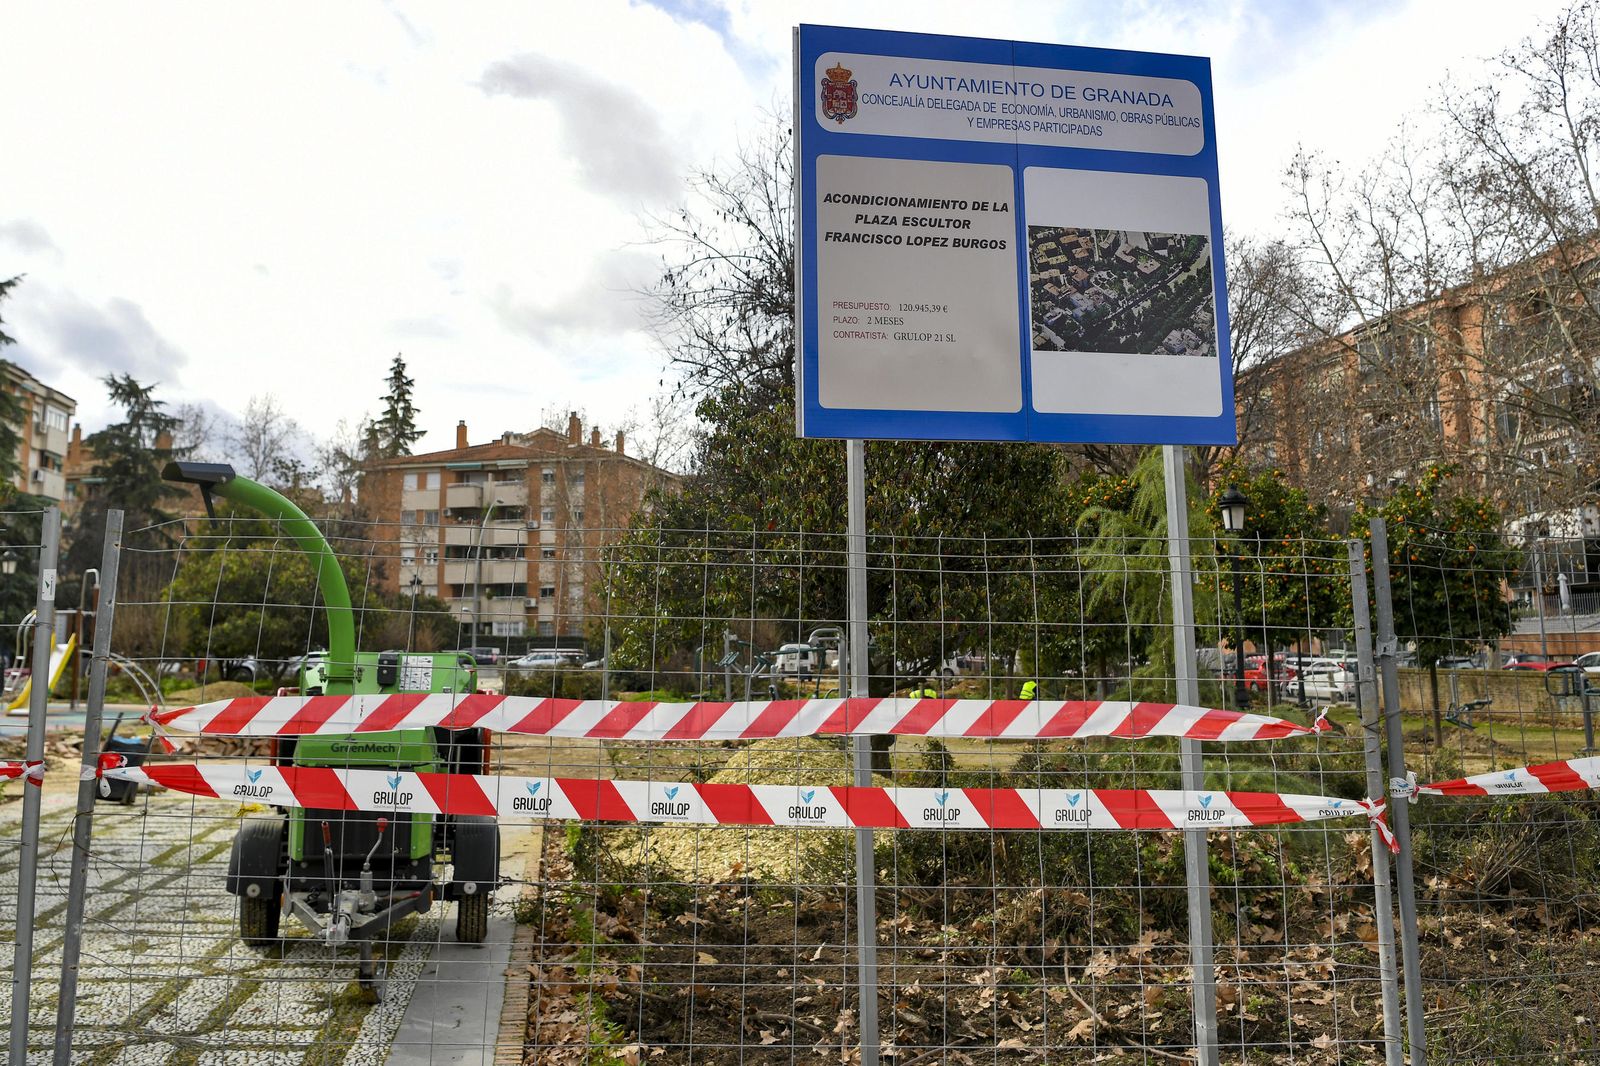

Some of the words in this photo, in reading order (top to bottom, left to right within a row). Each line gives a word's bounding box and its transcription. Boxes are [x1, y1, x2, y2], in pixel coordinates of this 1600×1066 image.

[889, 72, 1045, 98] AYUNTAMIENTO
[1051, 84, 1076, 100] DE
[1082, 87, 1174, 108] GRANADA
[862, 93, 925, 109] CONCEJALÍA
[927, 98, 981, 113] DELEGADA
[983, 101, 997, 114] DE
[1058, 107, 1119, 123] URBANISMO,
[1120, 111, 1154, 124] OBRAS
[1155, 111, 1201, 128] PÚBLICAS
[967, 117, 974, 128] Y
[976, 118, 1032, 132] EMPRESAS
[1033, 121, 1103, 137] PARTICIPADAS
[823, 193, 968, 211] ACONDICIONAMIENTO
[971, 201, 989, 212] DE
[992, 202, 1009, 213] LA
[854, 214, 898, 226] PLAZA
[901, 216, 971, 230] ESCULTOR
[824, 231, 902, 246] FRANCISCO
[906, 236, 949, 248] LOPEZ
[952, 238, 1007, 250] BURGOS
[898, 303, 941, 313] 120.945,39
[942, 305, 949, 314] €
[867, 316, 873, 326] 2
[874, 316, 905, 326] MESES
[893, 331, 933, 343] GRULOP
[934, 333, 944, 343] 21
[330, 742, 396, 753] GreenMech
[373, 791, 414, 805] GRULOP
[513, 797, 553, 811] GRULOP
[651, 802, 691, 816] GRULOP
[788, 806, 827, 820] GRULOP
[923, 808, 961, 821] GRULOP
[1055, 809, 1093, 822] GRULOP
[1187, 809, 1226, 822] GRULOP
